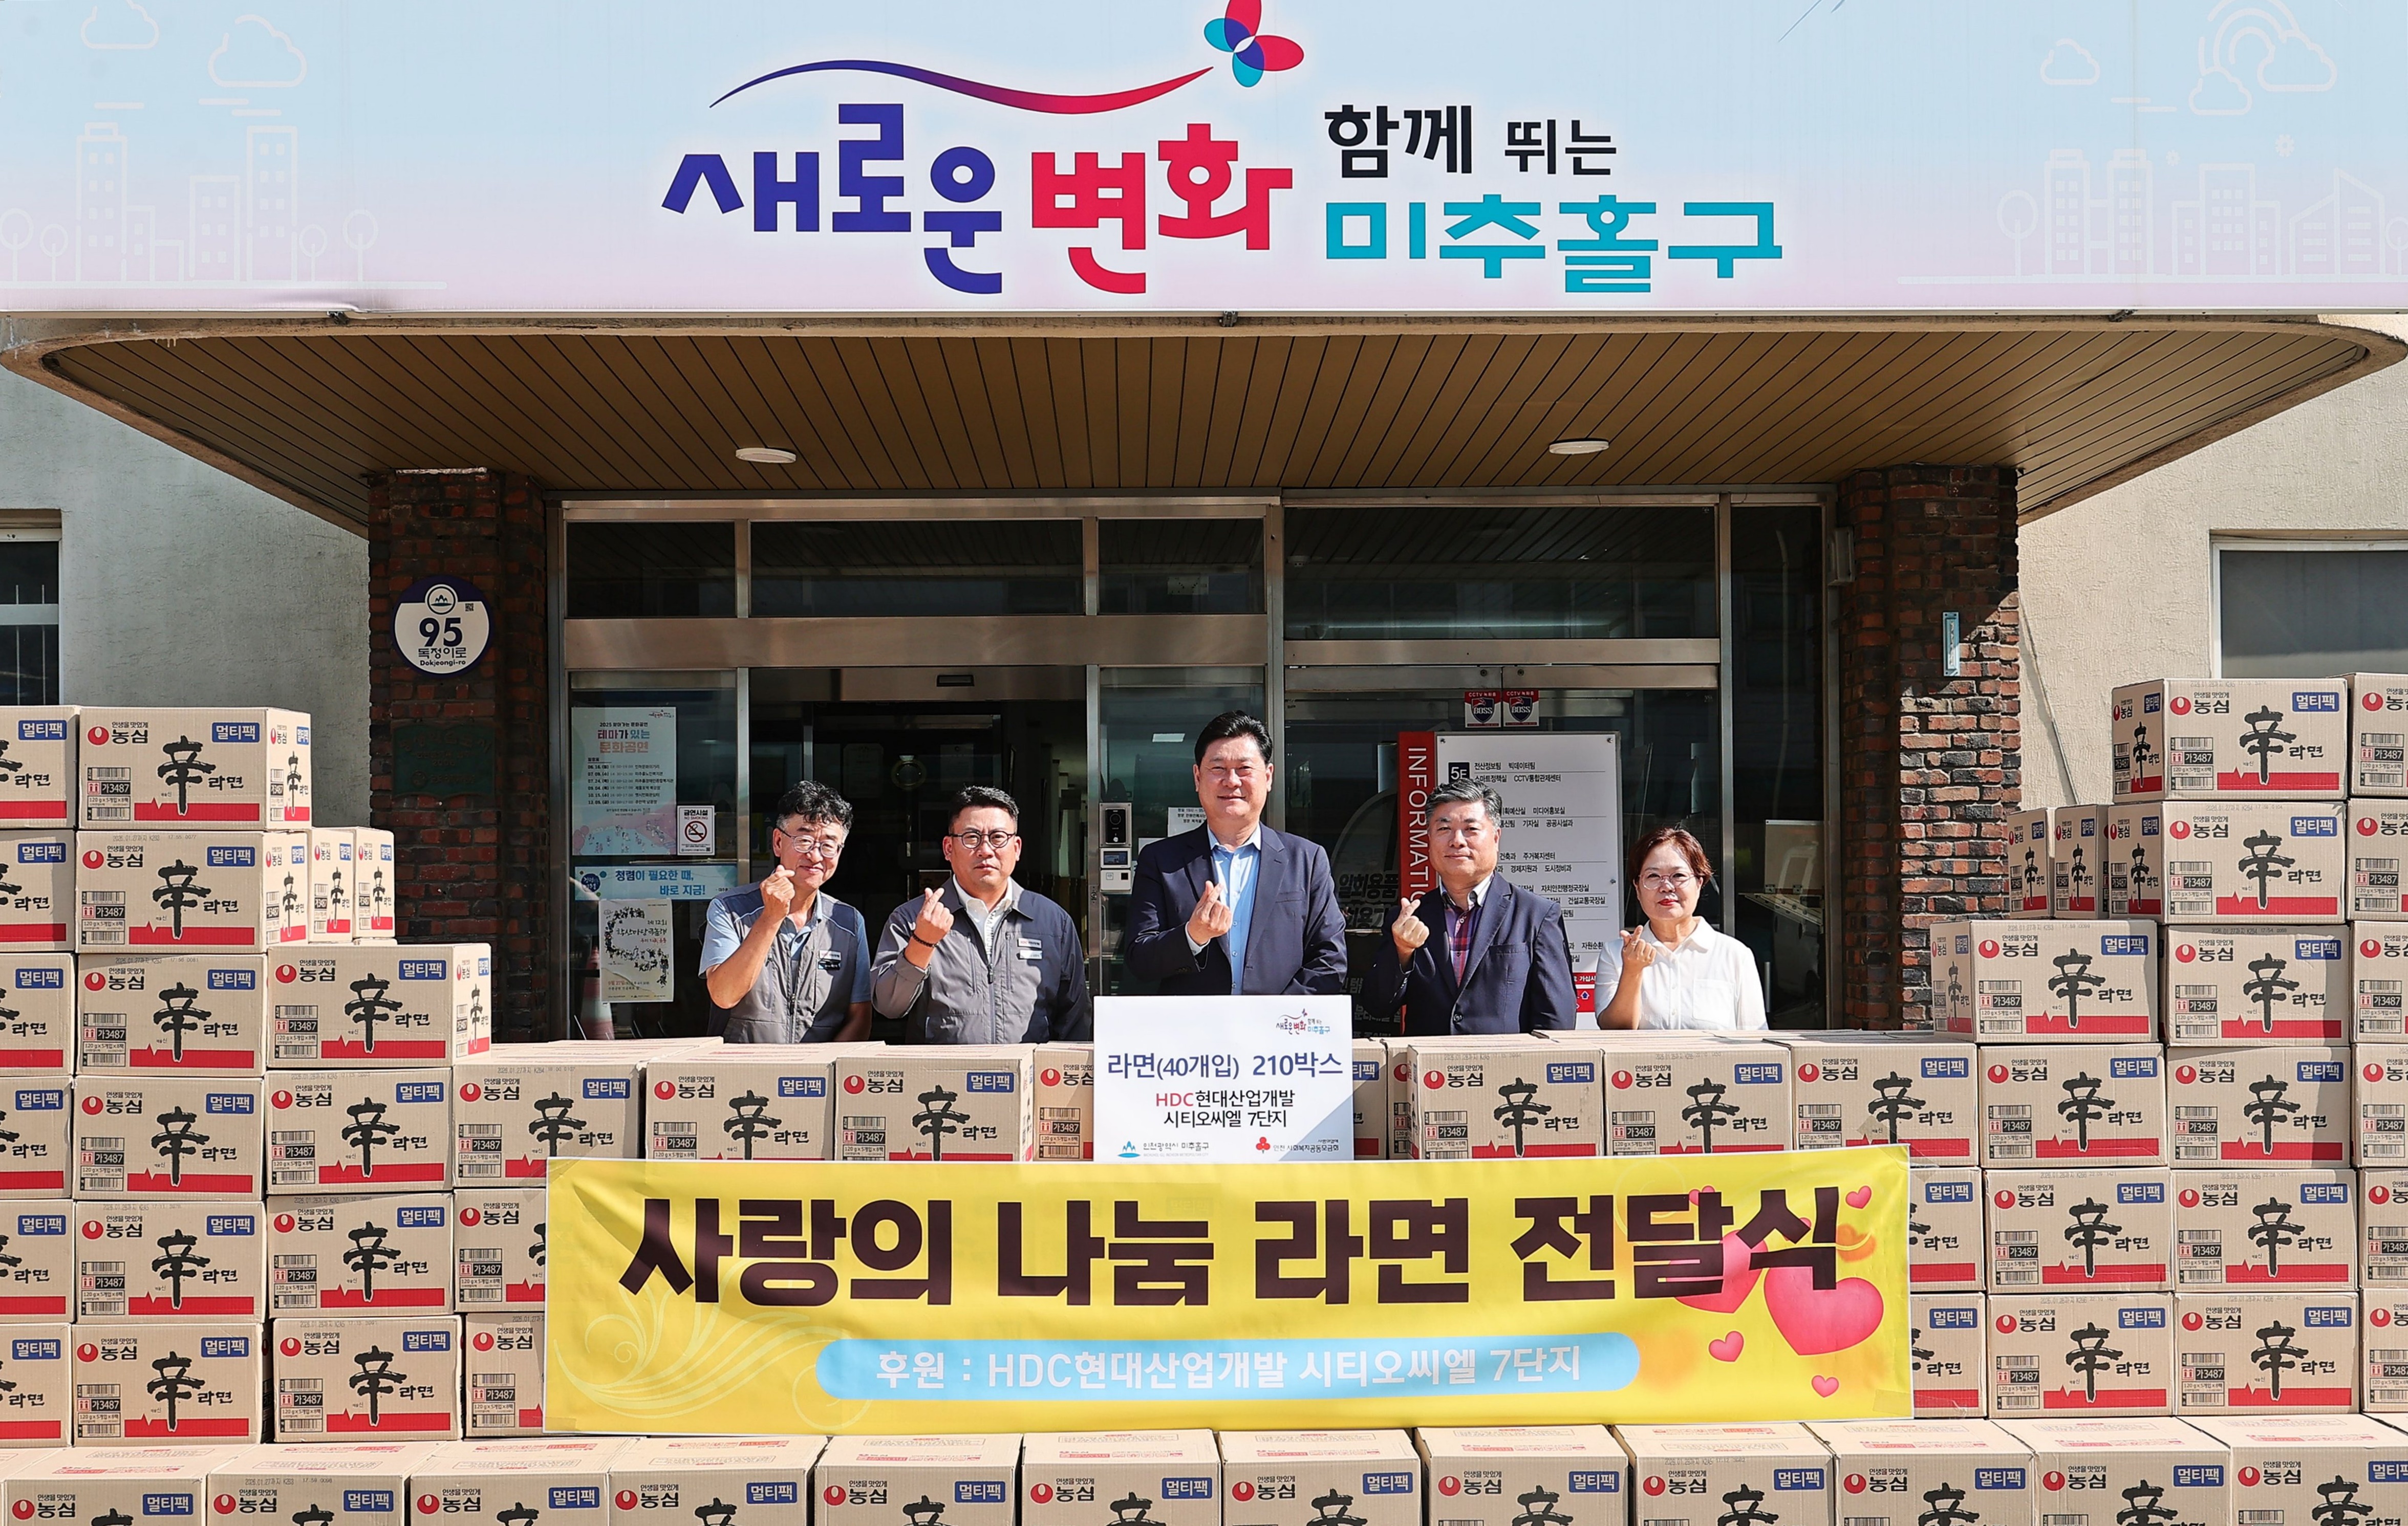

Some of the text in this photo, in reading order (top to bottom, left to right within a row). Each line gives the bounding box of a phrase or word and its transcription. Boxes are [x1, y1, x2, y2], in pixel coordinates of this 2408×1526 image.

[1324, 104, 1617, 178] 함께 뛰는
[661, 103, 1293, 294] 새로운 변화
[1326, 194, 1782, 293] 미추홀구
[419, 618, 463, 647] 95
[418, 647, 466, 659] 독정이로
[2194, 700, 2230, 714] 농심
[2296, 695, 2335, 709] 멀티팩
[2121, 705, 2133, 719] 농심
[112, 730, 148, 744] 농심
[217, 726, 255, 740] 멀티팩
[598, 730, 650, 739] 테마가 있는
[600, 742, 648, 753] 문화공연
[2185, 753, 2212, 762] 가3487
[1451, 767, 1467, 779] 5F
[1474, 762, 1536, 770] 전산정보팀 빅데이터팀
[1514, 774, 1561, 782] CCTV통합관제센터
[102, 783, 129, 793] 가3487
[1523, 819, 1539, 827] 기자실
[106, 854, 143, 867] 농심
[212, 850, 251, 864] 멀티팩
[615, 870, 694, 881] 청렴이 필요한 때,
[660, 885, 679, 896] 바로
[682, 885, 705, 896] 지금!
[1541, 884, 1589, 892] 자치안전행정국장실
[1568, 897, 1605, 905] 건설교통국장실
[97, 907, 123, 917] 가3487
[2002, 943, 2039, 957] 농심
[2105, 939, 2144, 953] 멀티팩
[1994, 996, 2020, 1006] 가3487
[1276, 1018, 1306, 1035] 새로운 변화
[1307, 1026, 1330, 1034] 미추홀구
[1108, 1052, 1343, 1080] 라면(40개입) 210박스
[1447, 1073, 1484, 1087] 농심
[1551, 1066, 1590, 1081] 멀티팩
[678, 1084, 715, 1098] 농심
[783, 1080, 822, 1095] 멀티팩
[1156, 1090, 1295, 1108] HDC현대산업개발
[1164, 1110, 1286, 1128] 시티오씨엘 7단지
[774, 1130, 809, 1145] 라면
[1439, 1127, 1466, 1136] 가3487
[669, 1138, 695, 1147] 가3487
[1144, 1142, 1209, 1151] 인천광역시 미추홀구
[618, 1186, 1839, 1307] 사랑의 나눔 라면 전달식
[2019, 1318, 2056, 1332] 농심
[2122, 1312, 2161, 1326] 멀티팩
[304, 1341, 340, 1355] 농심
[407, 1335, 446, 1349] 멀티팩
[876, 1351, 944, 1388] 후원
[989, 1351, 1288, 1388] HDC현대산업개발
[1299, 1349, 1475, 1387] 시티오씨엘
[1490, 1345, 1580, 1382] 7단지
[2011, 1372, 2038, 1381] 가3487
[295, 1395, 321, 1404] 가3487
[1056, 1487, 1094, 1501] 농심
[1167, 1481, 1208, 1496] 멀티팩
[239, 1498, 277, 1513] 농심
[348, 1494, 390, 1509] 멀티팩
